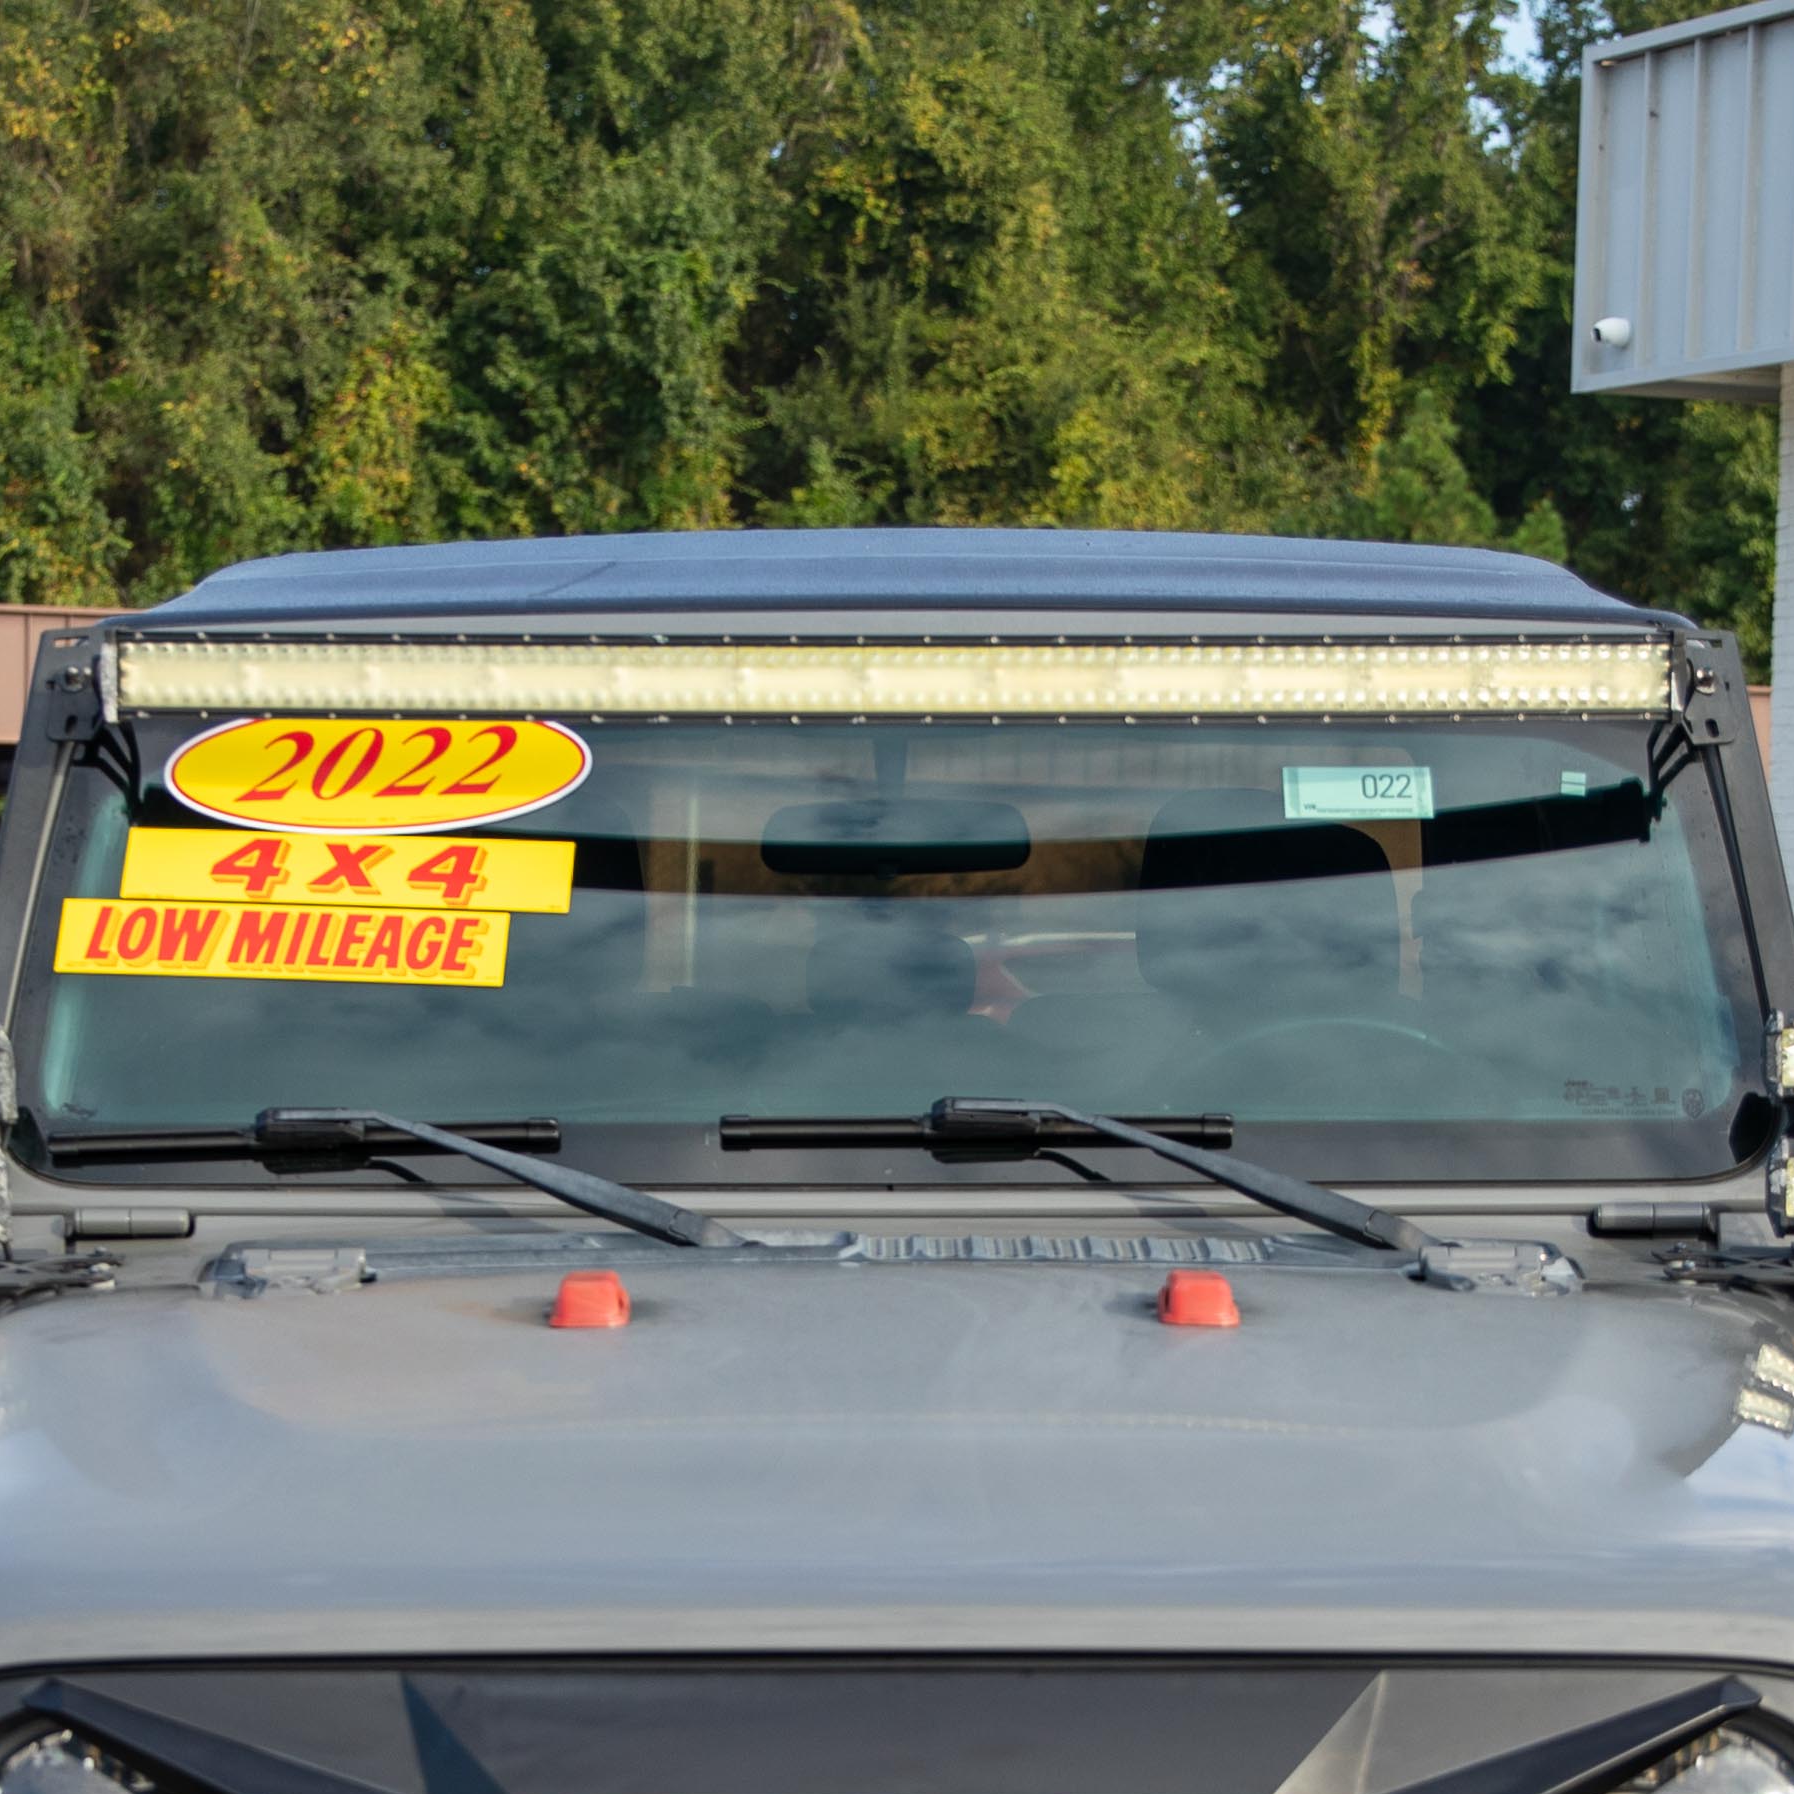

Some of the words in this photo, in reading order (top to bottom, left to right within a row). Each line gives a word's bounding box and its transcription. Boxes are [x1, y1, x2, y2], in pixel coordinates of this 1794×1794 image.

[234, 725, 518, 802] 2022
[1361, 774, 1413, 799] 022
[210, 839, 287, 896] 4
[407, 845, 483, 903] 4
[85, 905, 224, 964] LOW
[226, 911, 484, 974] MILEAGE
